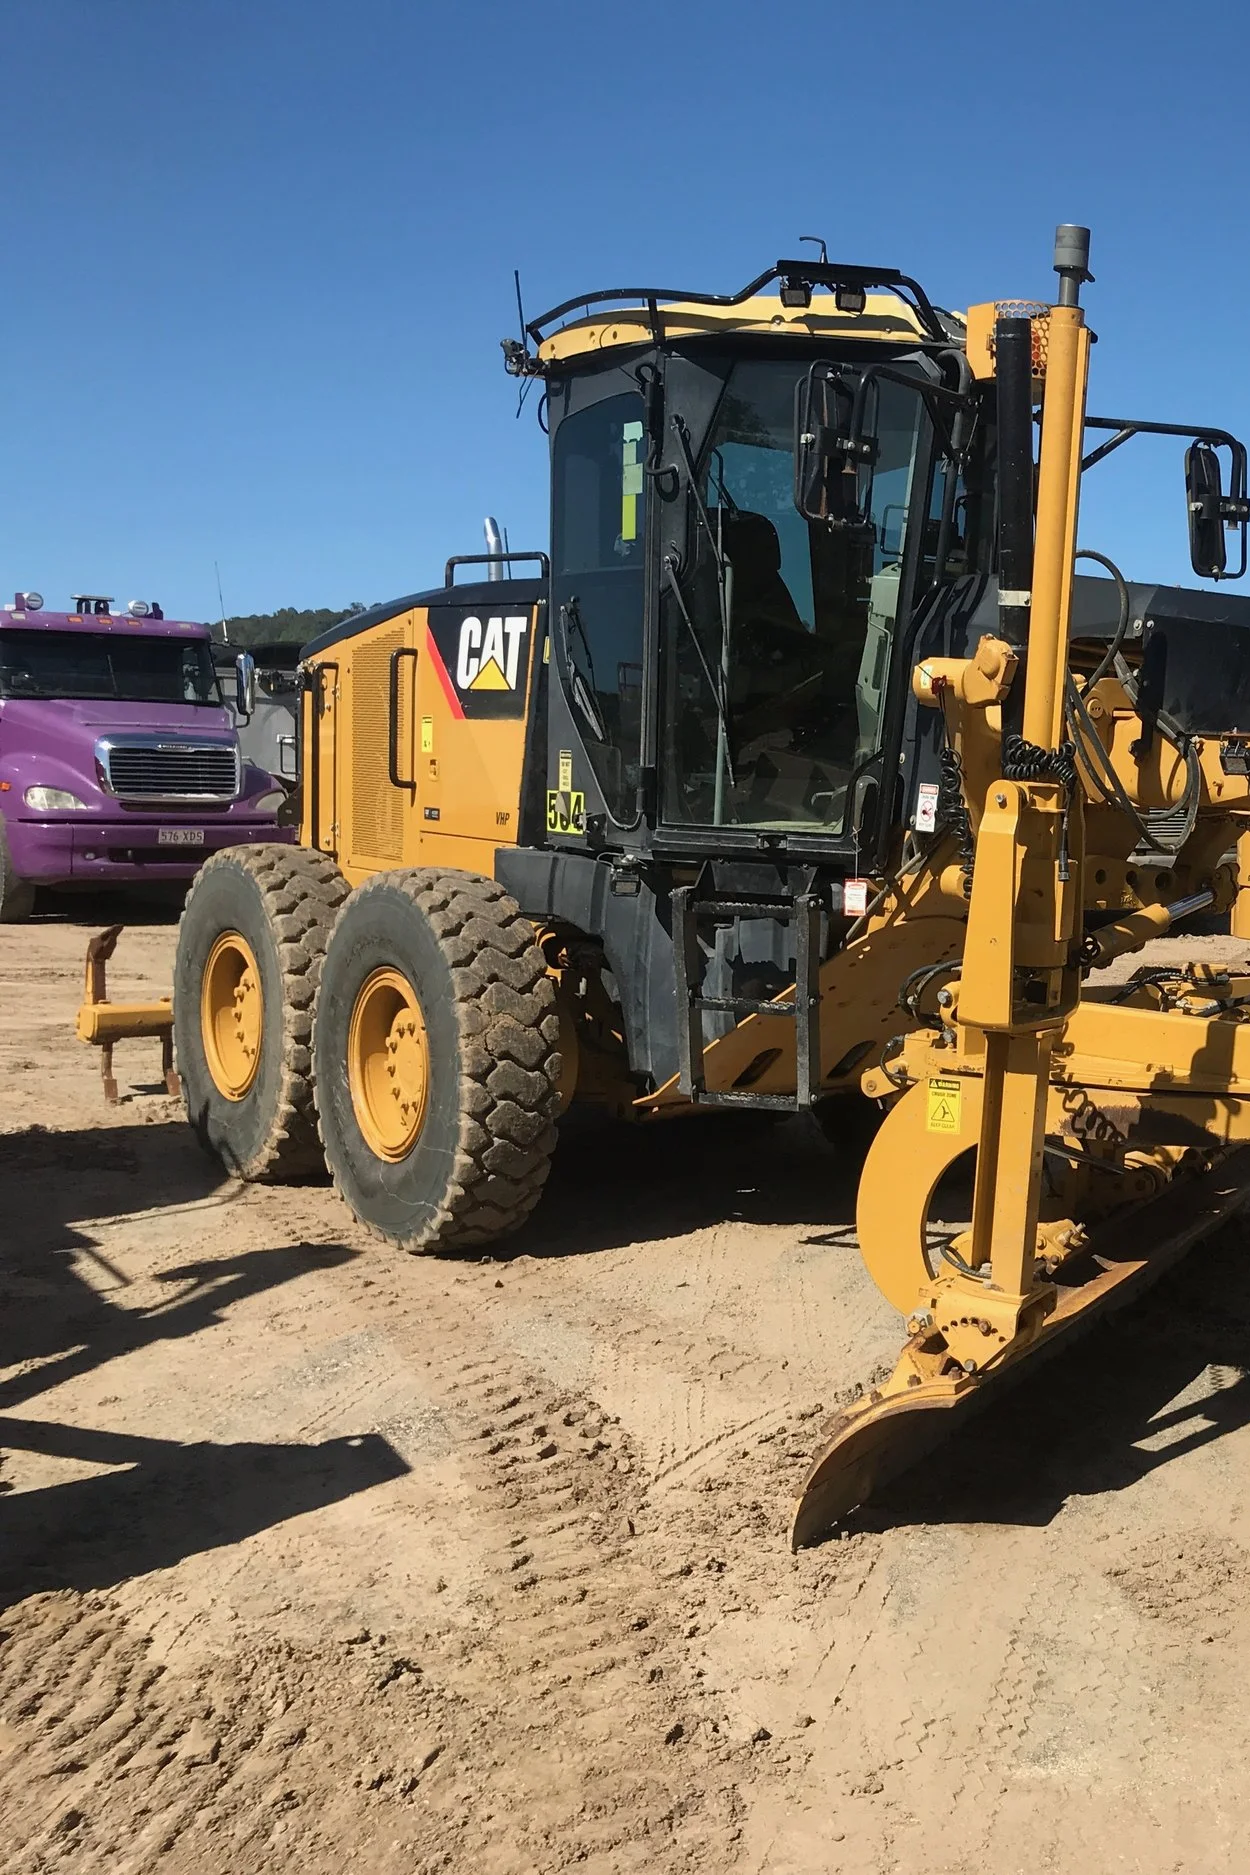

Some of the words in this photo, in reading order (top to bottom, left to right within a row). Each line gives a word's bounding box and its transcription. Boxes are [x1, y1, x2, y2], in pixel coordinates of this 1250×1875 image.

[457, 616, 528, 690] CAT
[495, 811, 511, 826] VHP
[161, 831, 179, 841] 576
[183, 831, 203, 841] XDS
